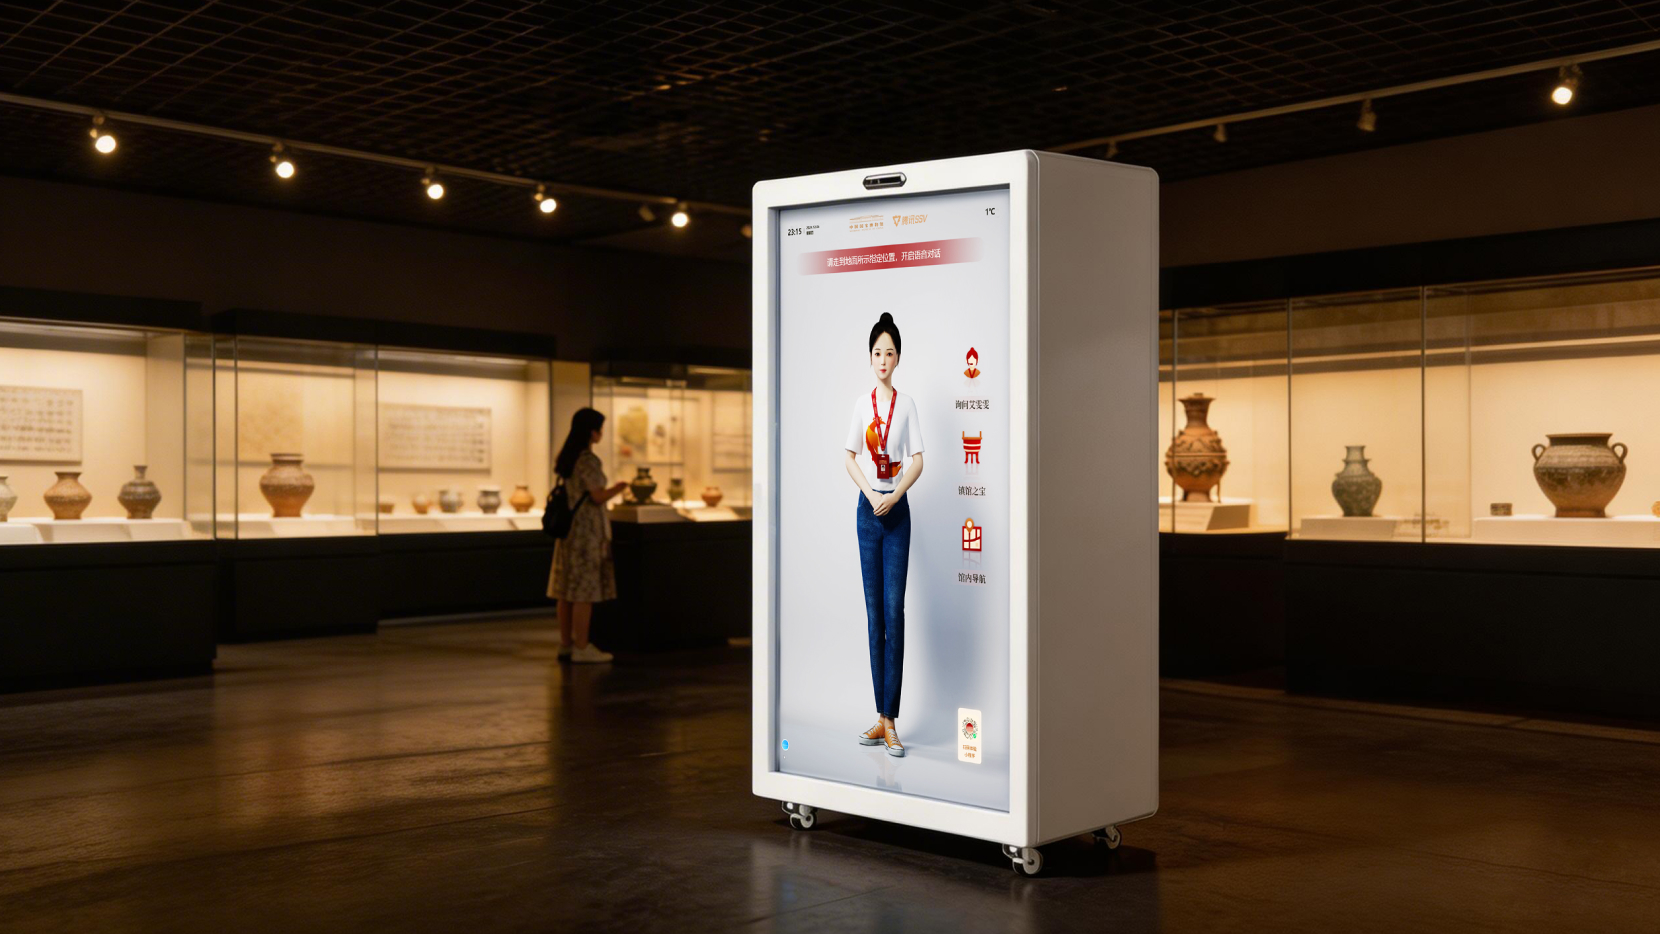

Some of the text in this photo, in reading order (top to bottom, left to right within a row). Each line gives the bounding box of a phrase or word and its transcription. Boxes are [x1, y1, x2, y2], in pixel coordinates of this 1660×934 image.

[788, 228, 802, 236] 23:15
[955, 400, 990, 410] 询问艾雯雯
[958, 486, 986, 496] 镇馆之宝
[958, 572, 986, 584] 馆内导航
